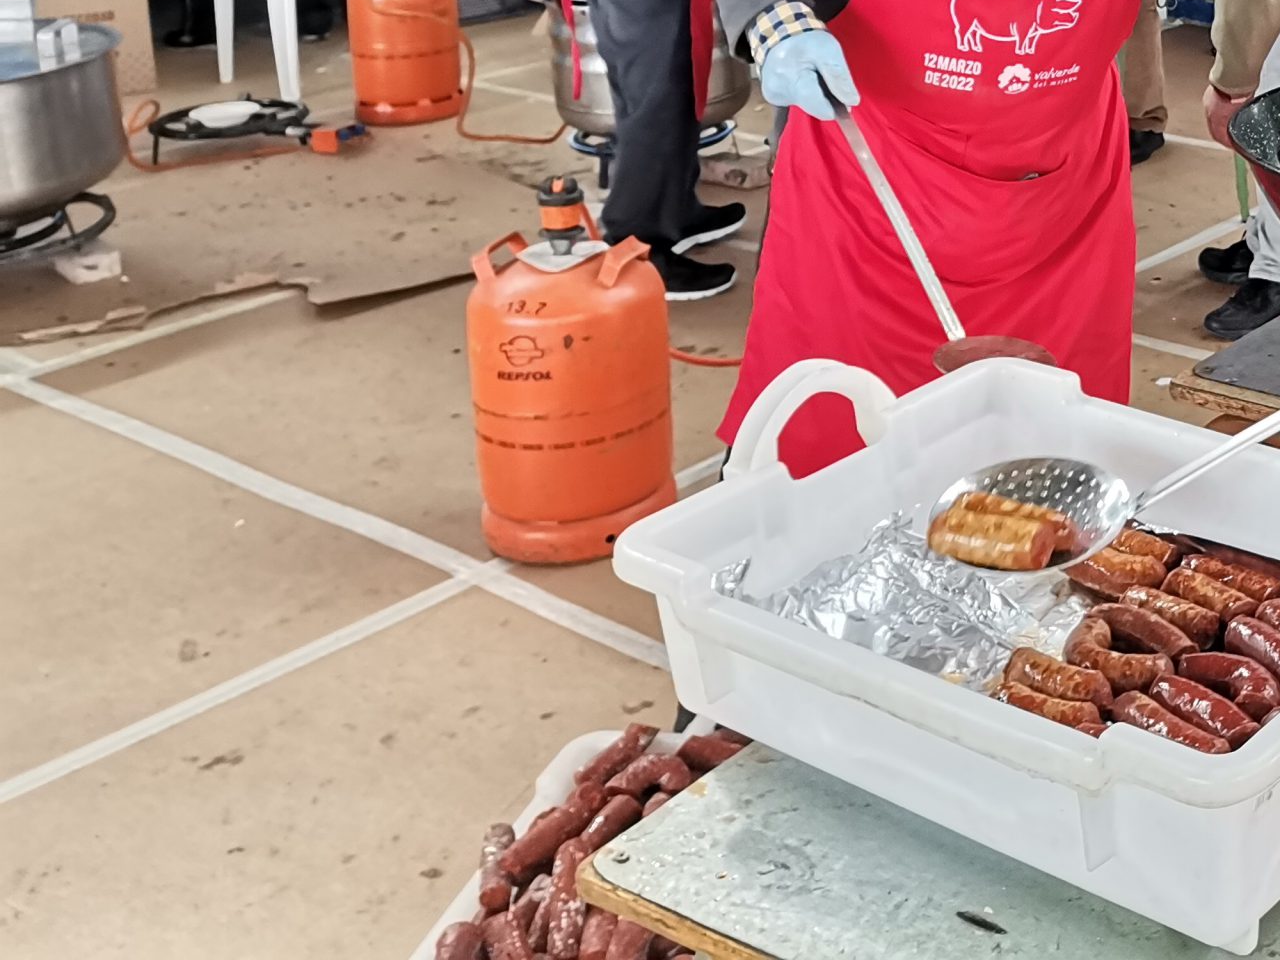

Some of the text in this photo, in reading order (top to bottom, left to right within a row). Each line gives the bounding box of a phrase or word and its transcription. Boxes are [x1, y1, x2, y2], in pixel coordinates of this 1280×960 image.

[924, 53, 982, 75] 12 MARZO
[924, 70, 975, 91] DE 2022
[497, 371, 553, 381] REPSOL
